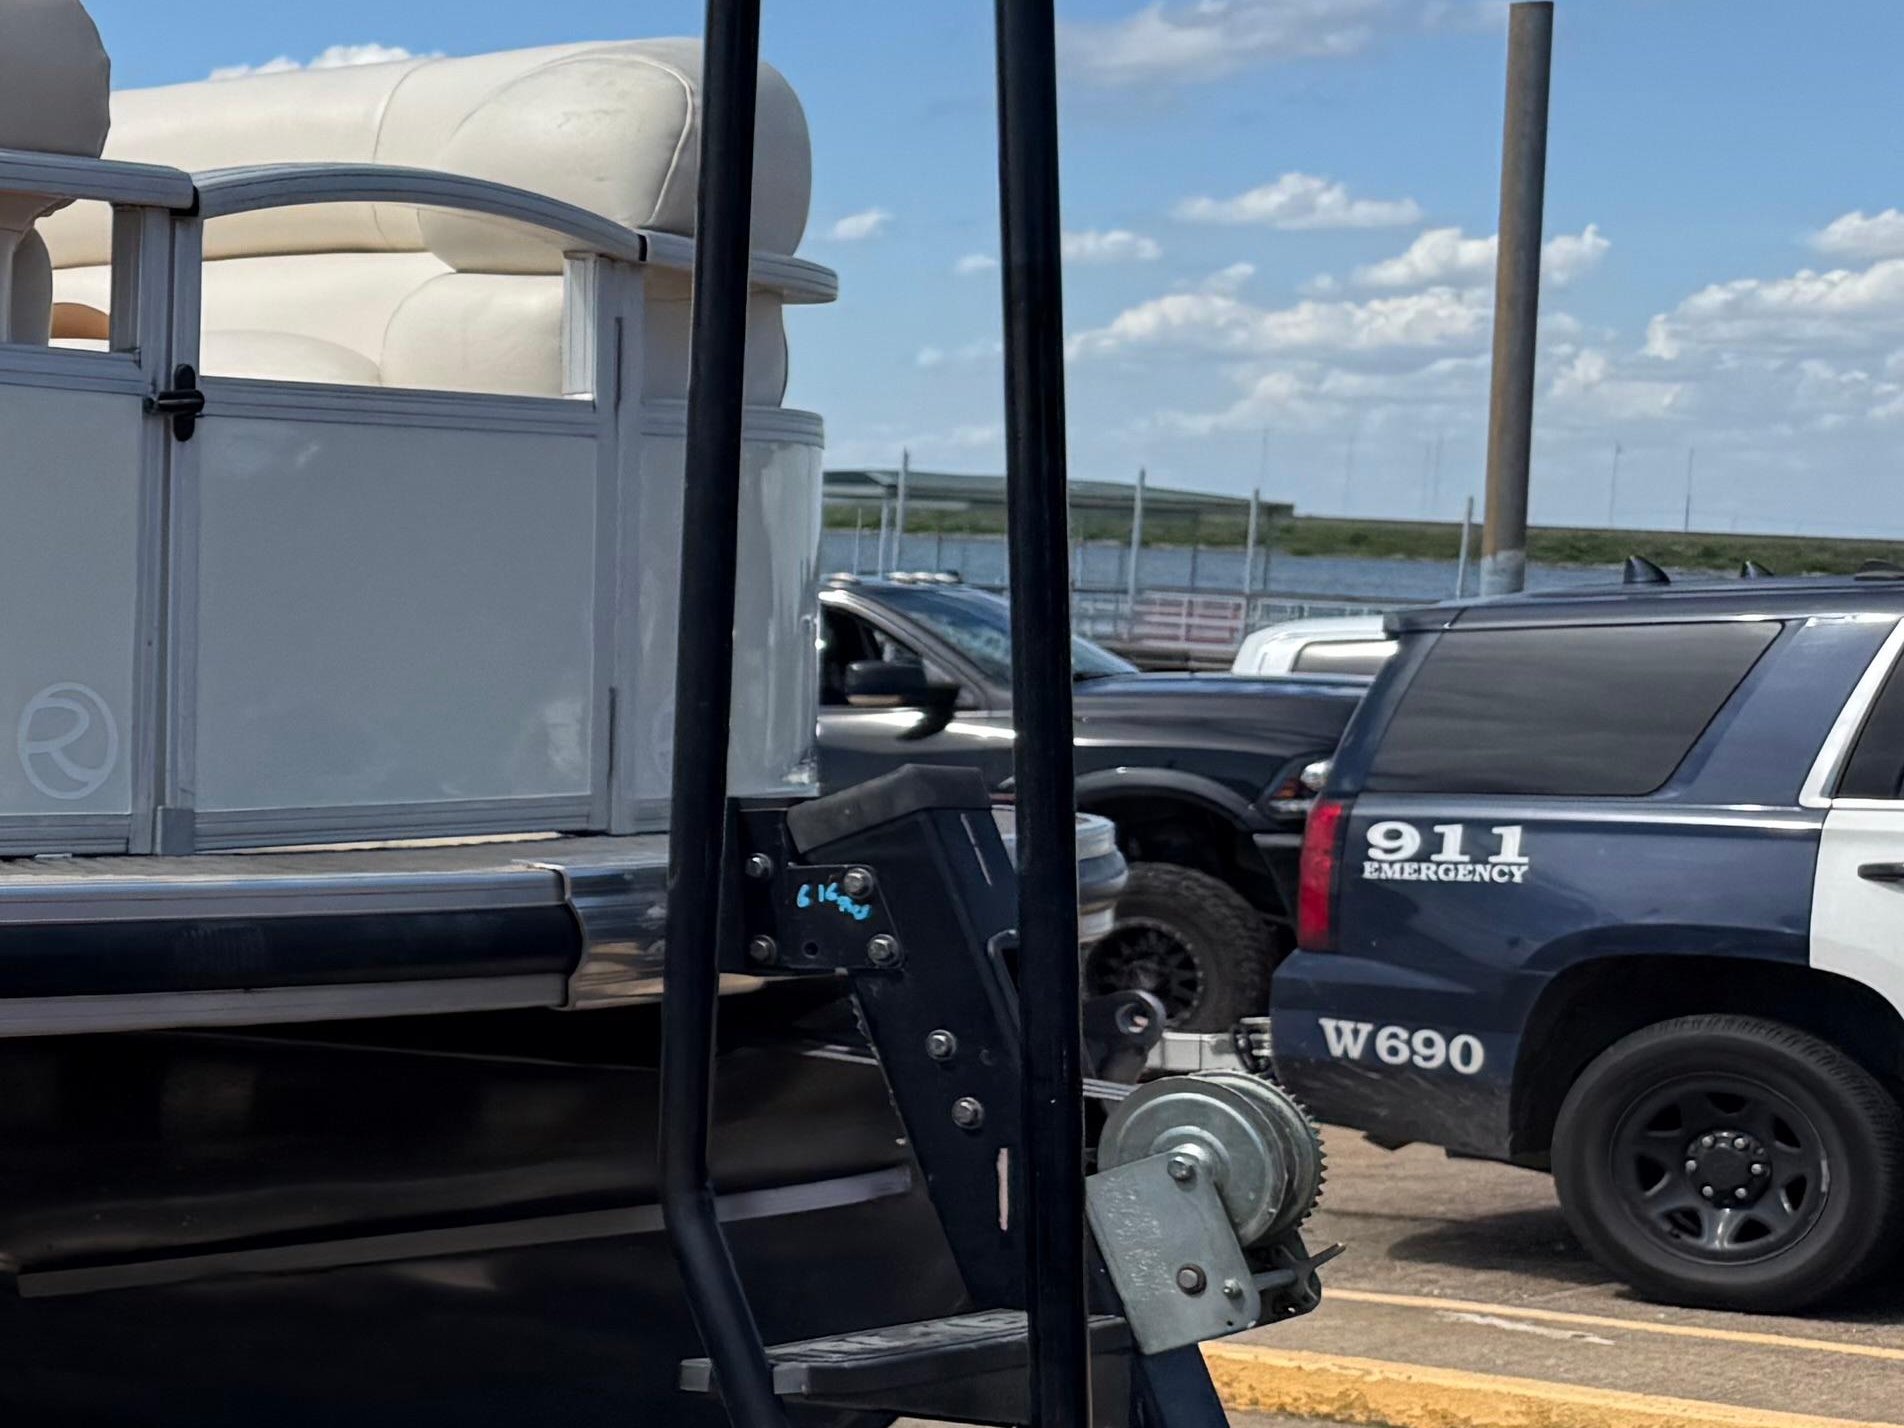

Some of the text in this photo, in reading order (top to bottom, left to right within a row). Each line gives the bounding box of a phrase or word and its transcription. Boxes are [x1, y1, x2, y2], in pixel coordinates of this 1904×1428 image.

[1366, 820, 1529, 864] 911
[1362, 860, 1529, 884] EMERGENCY
[1318, 1017, 1485, 1075] W690
